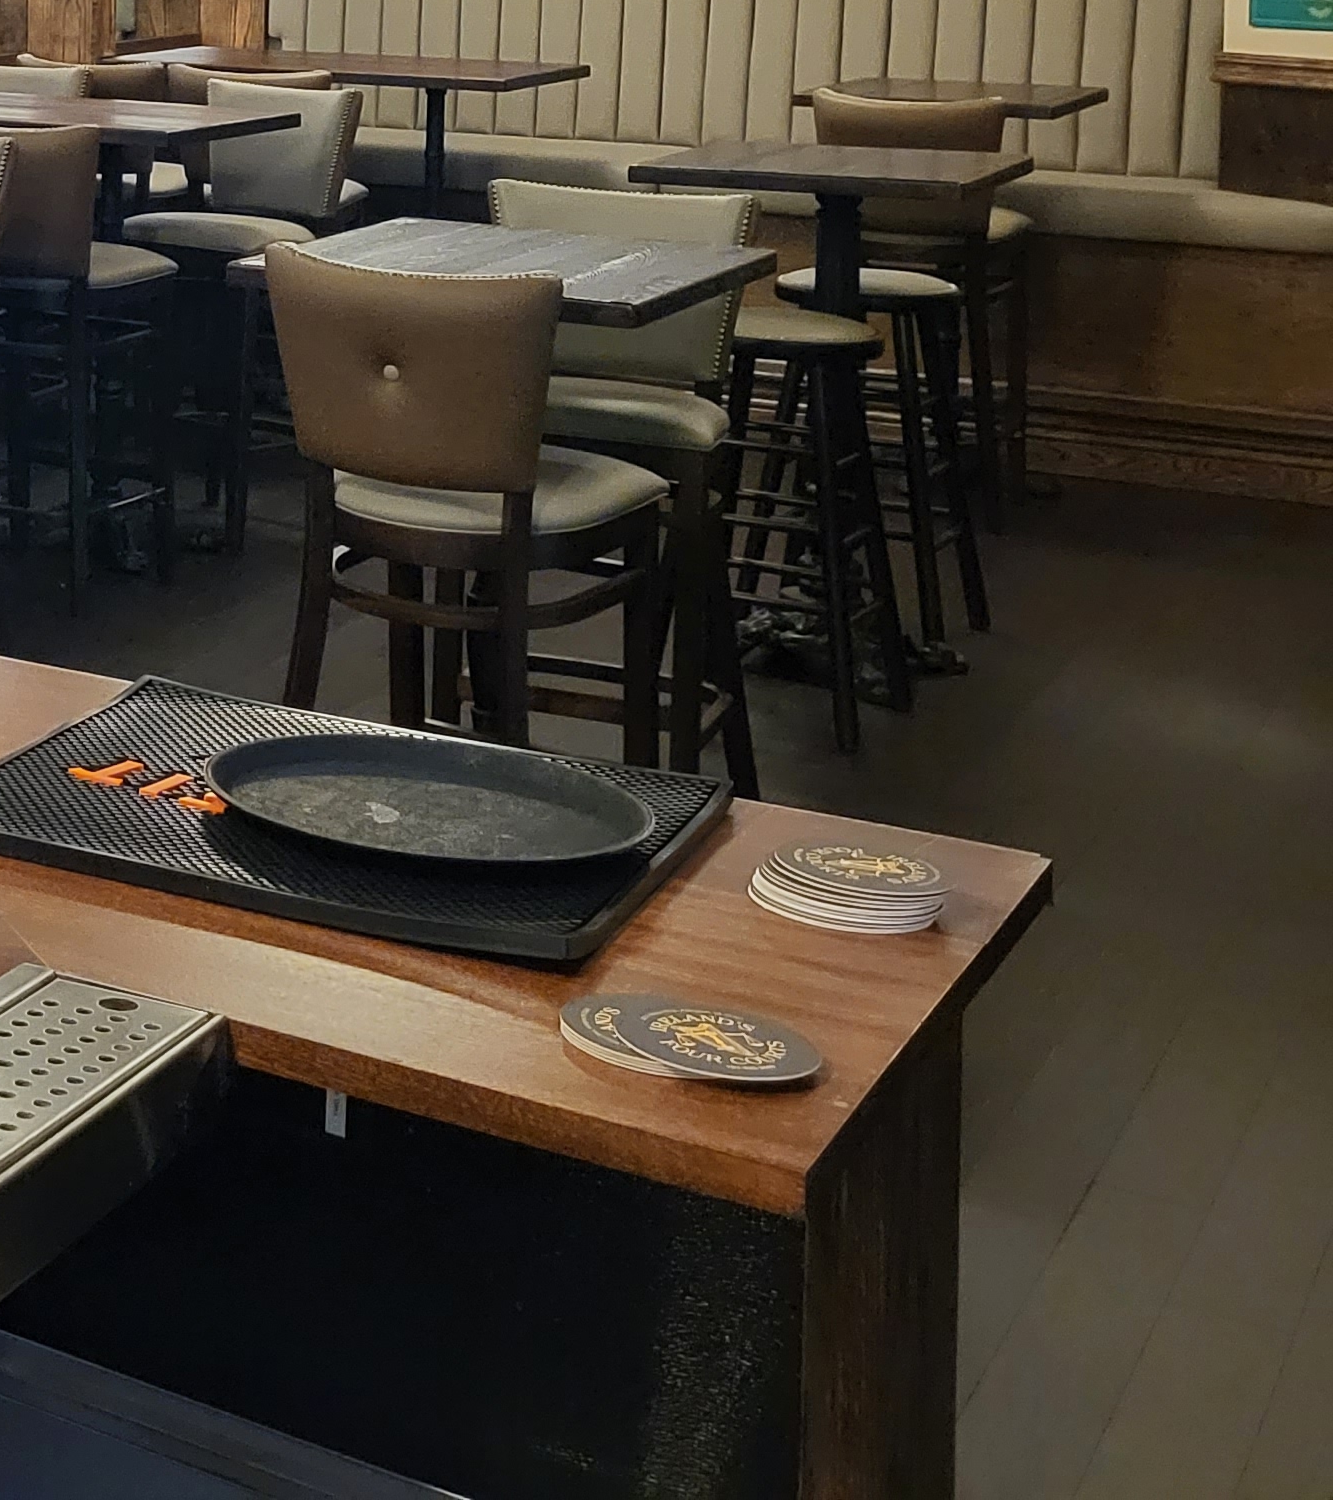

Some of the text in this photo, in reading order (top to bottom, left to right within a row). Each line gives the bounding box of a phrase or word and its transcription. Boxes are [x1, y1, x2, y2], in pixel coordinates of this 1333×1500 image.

[648, 1012, 756, 1033] IRELAND'S
[659, 1038, 788, 1067] FOUR COURTS
